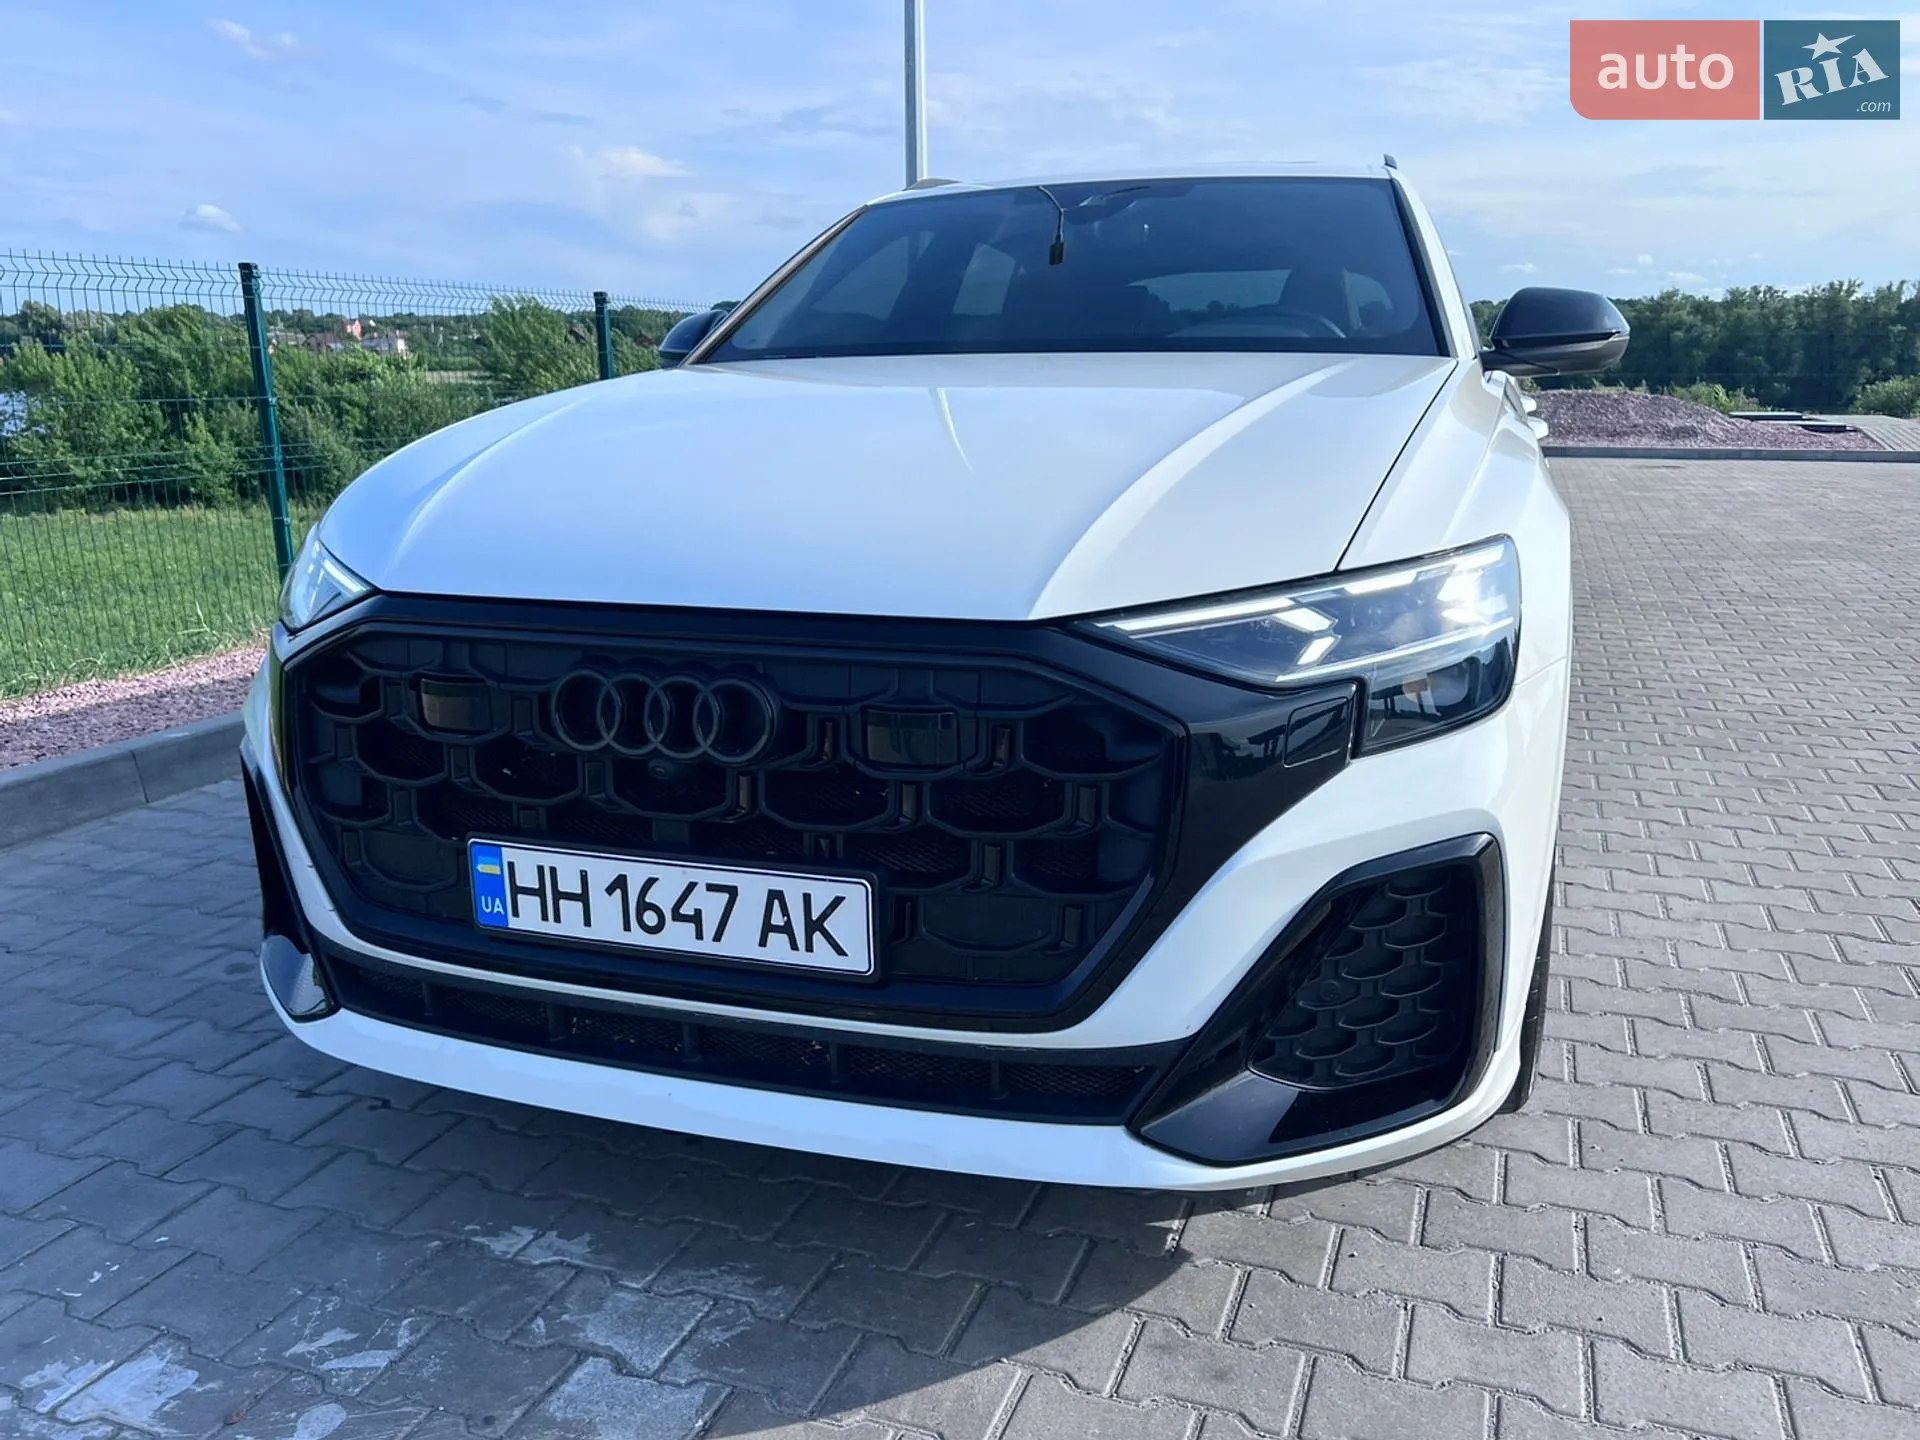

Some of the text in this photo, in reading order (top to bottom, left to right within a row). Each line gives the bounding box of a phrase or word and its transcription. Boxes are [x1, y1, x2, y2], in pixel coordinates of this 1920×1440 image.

[481, 897, 505, 914] UA
[506, 860, 849, 957] HH 1647 AK
